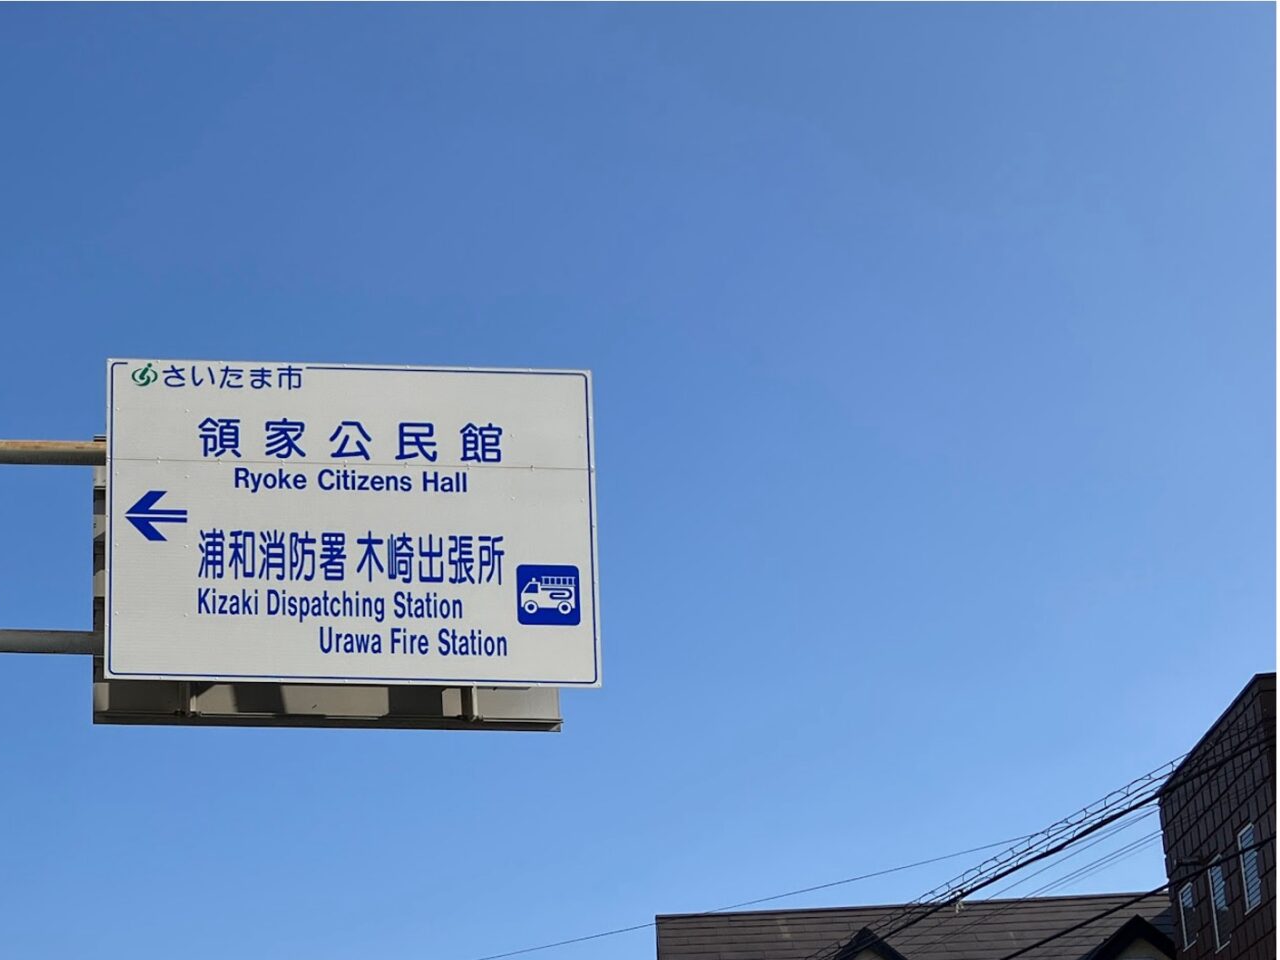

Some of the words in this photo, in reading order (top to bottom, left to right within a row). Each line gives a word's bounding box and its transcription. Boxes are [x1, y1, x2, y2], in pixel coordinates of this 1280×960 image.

[162, 365, 303, 390] さいたま市
[198, 416, 503, 463] 領家公民館
[234, 467, 308, 492] Ryoke
[317, 469, 412, 492] Citizens
[422, 471, 468, 493] Hall
[197, 528, 347, 582] 浦和消防署
[356, 530, 505, 585] 木崎出張所
[197, 588, 259, 616] Kizaki
[267, 590, 385, 622] Dispatching
[393, 592, 463, 620] Station
[319, 627, 383, 655] Urawa
[391, 629, 429, 656] Fire
[438, 628, 508, 657] Station
